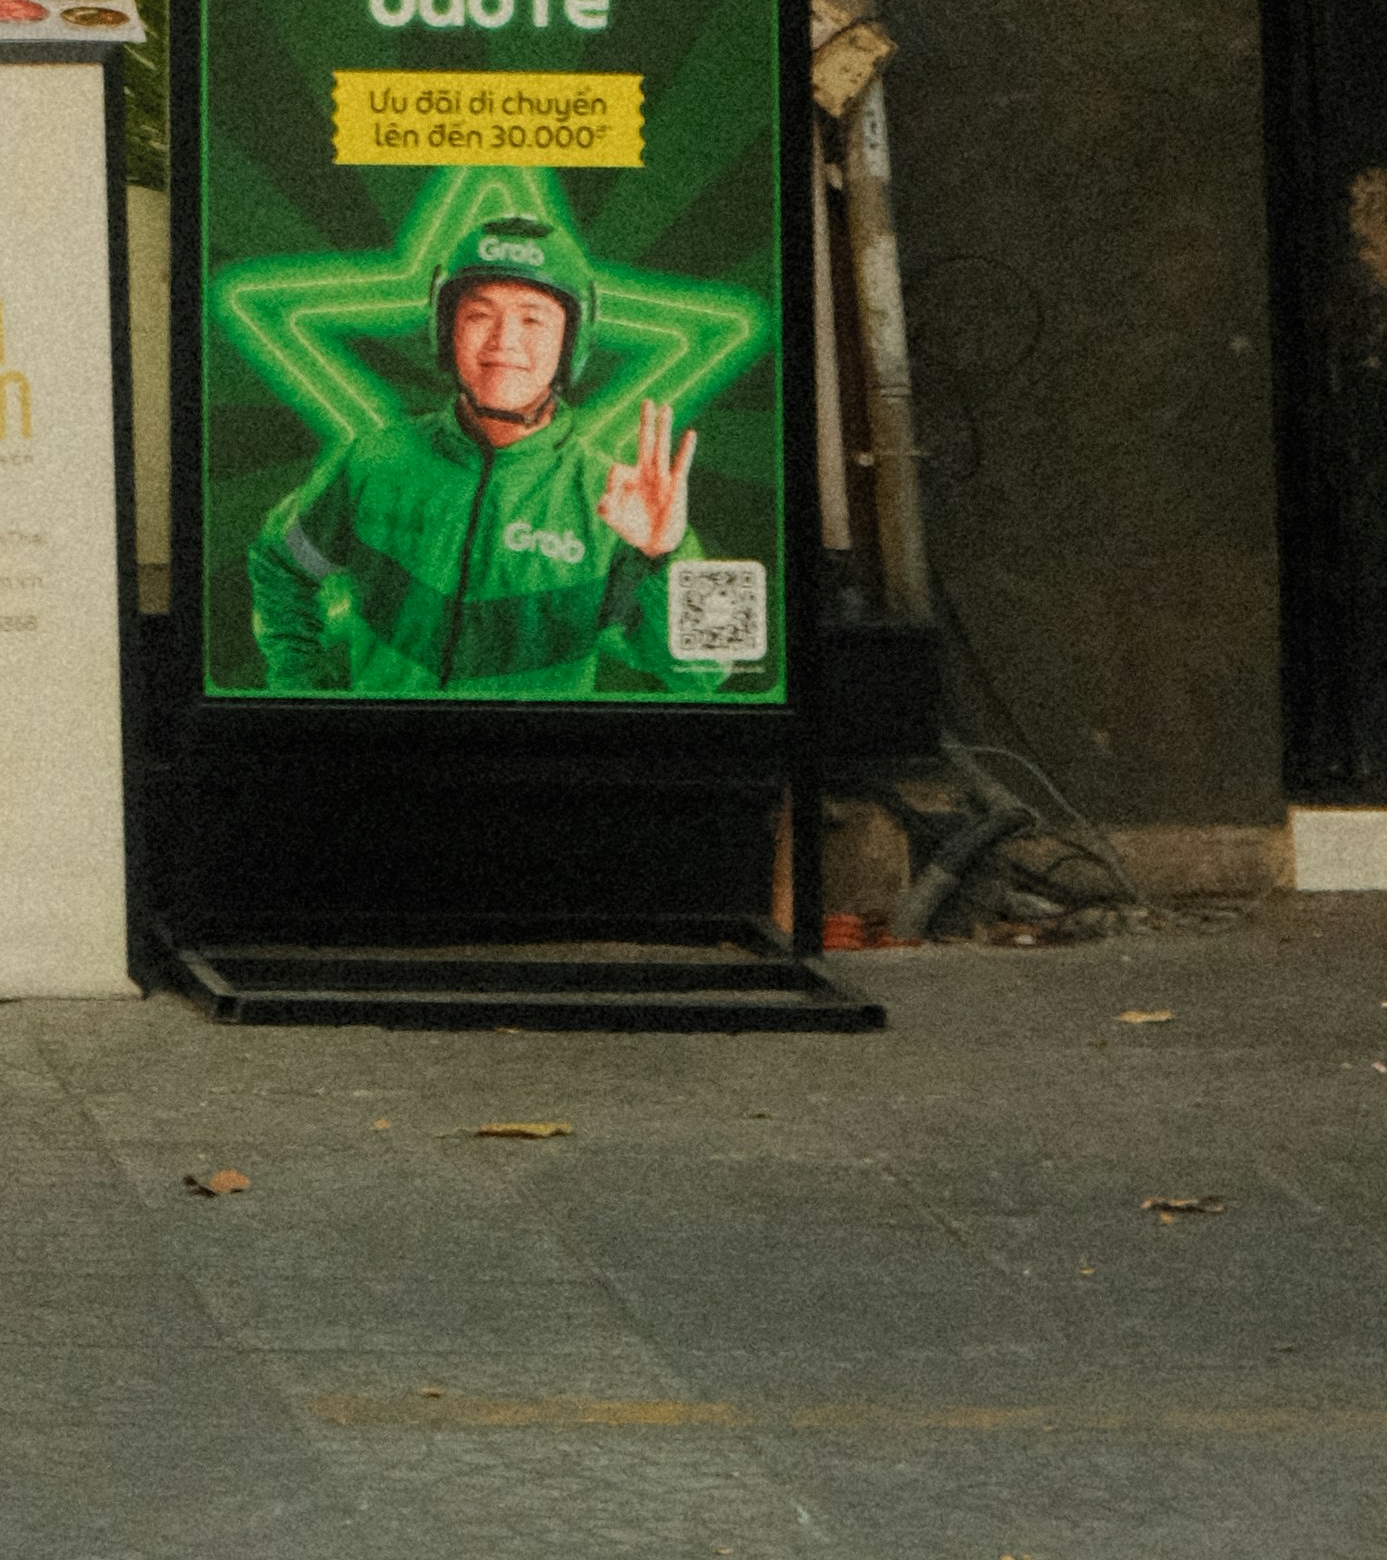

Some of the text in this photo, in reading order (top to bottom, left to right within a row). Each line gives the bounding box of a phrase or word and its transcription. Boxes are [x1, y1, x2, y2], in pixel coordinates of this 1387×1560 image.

[368, 87, 409, 115] Ưu
[373, 122, 419, 148] lên
[427, 120, 484, 149] đến
[478, 235, 546, 267] Grab
[502, 519, 586, 565] Grab
